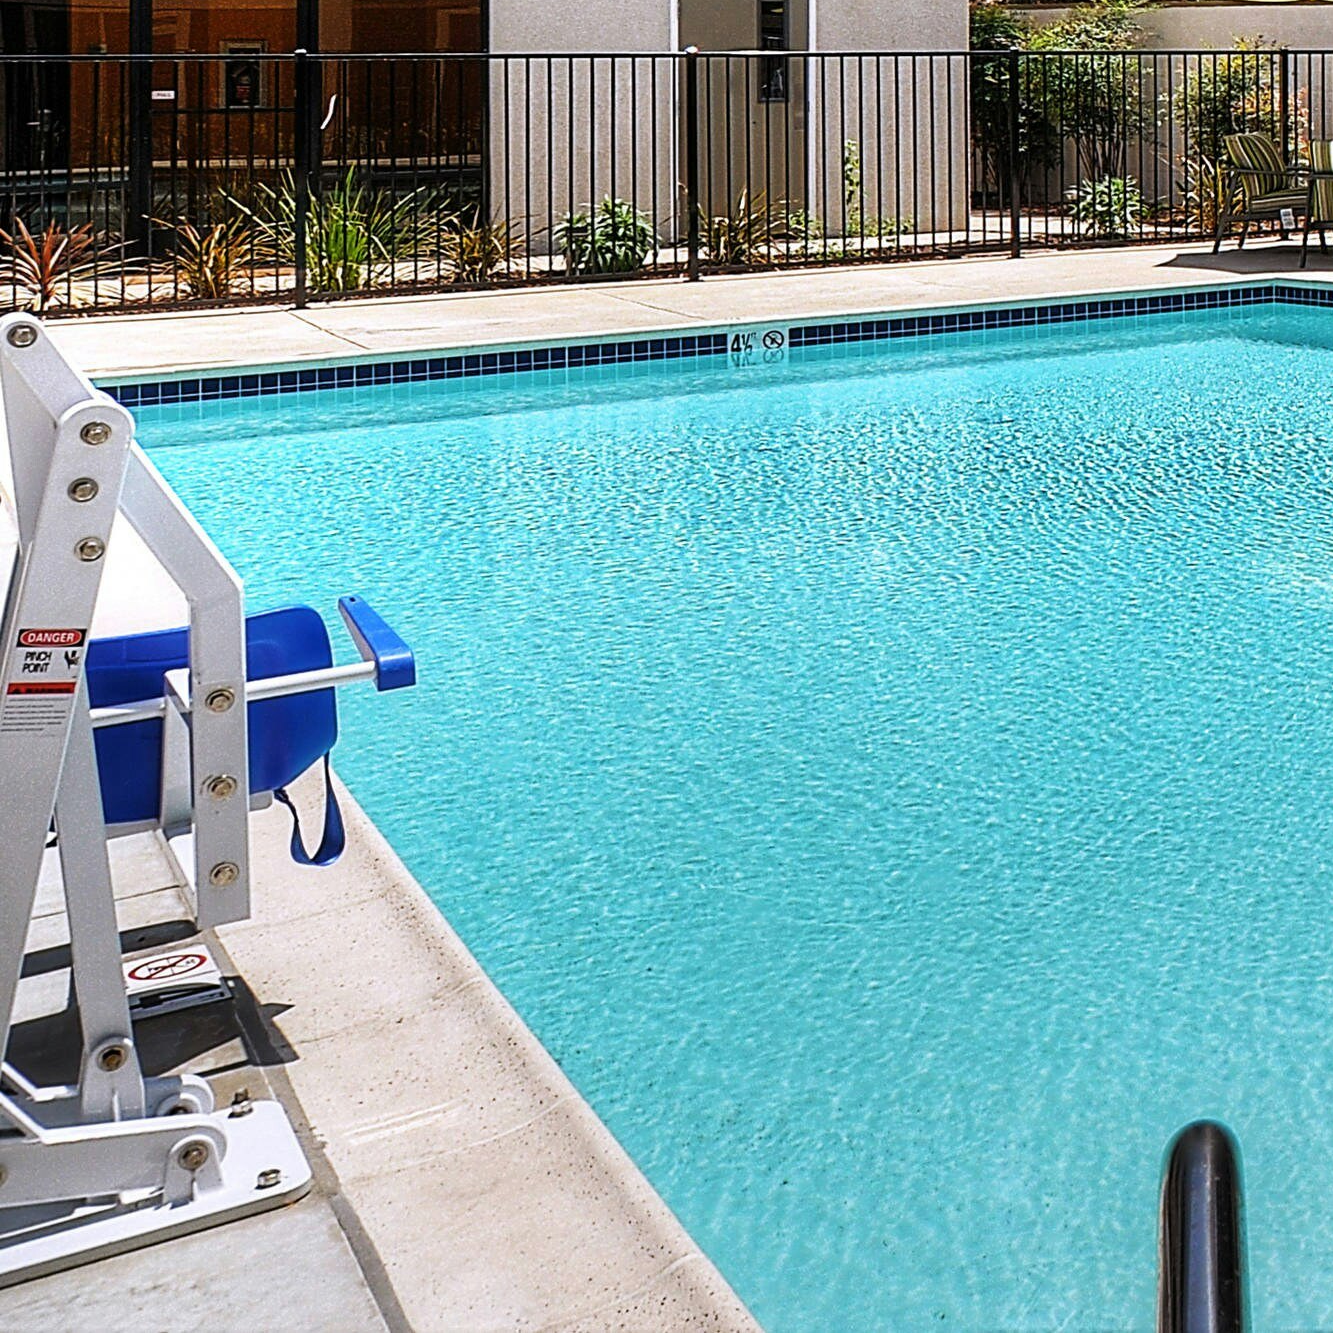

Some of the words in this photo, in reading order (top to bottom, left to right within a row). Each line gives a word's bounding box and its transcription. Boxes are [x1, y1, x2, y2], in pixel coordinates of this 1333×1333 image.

[27, 633, 74, 642] DANGER
[24, 651, 52, 662] PINCH
[21, 662, 50, 673] POINT
